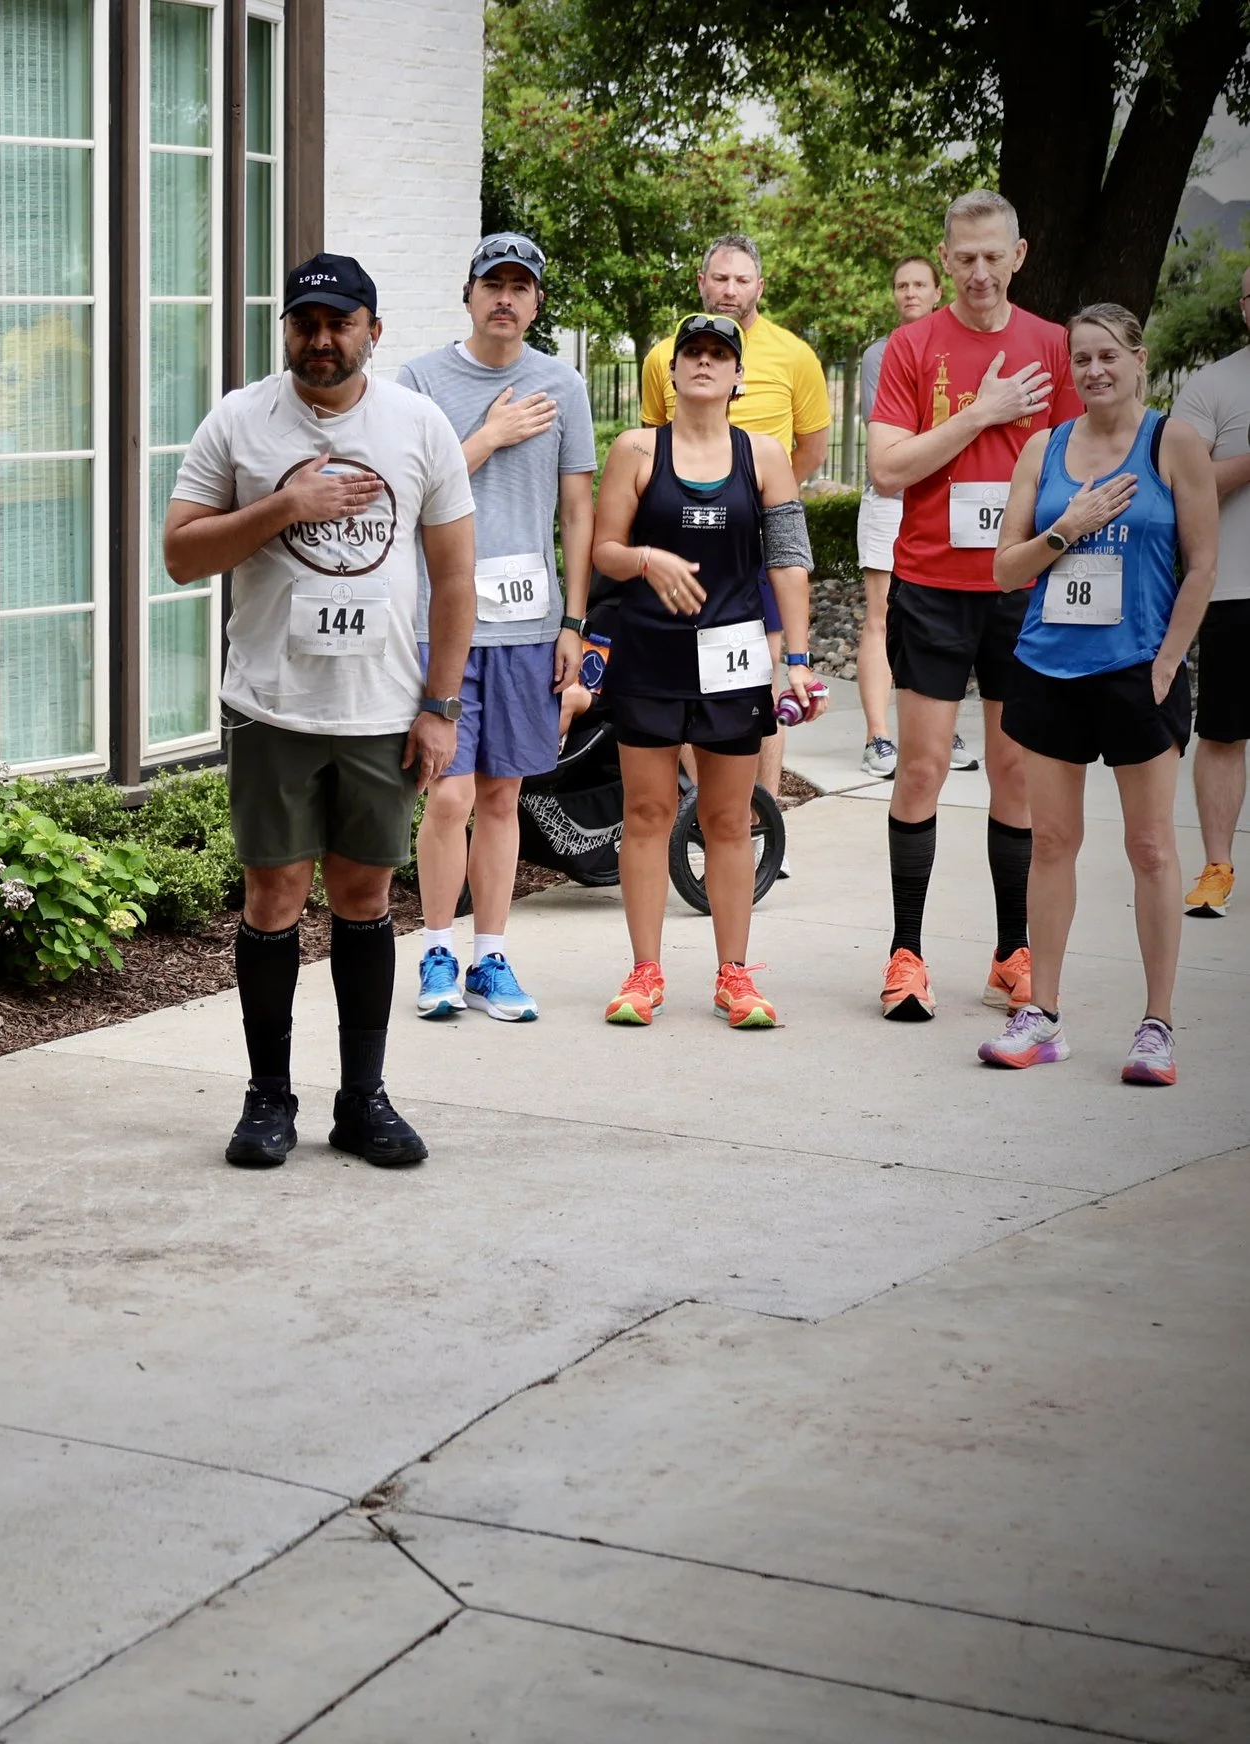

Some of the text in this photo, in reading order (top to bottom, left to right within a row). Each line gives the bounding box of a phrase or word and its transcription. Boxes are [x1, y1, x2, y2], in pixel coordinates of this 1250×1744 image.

[299, 274, 338, 283] LOYOLA
[979, 507, 1004, 530] 97
[289, 517, 387, 547] MUSTANG
[1094, 545, 1115, 555] CLUB
[497, 579, 534, 605] 108
[1066, 581, 1091, 605] 98
[317, 607, 365, 635] 144
[726, 649, 749, 672] 14
[241, 924, 261, 940] RUN
